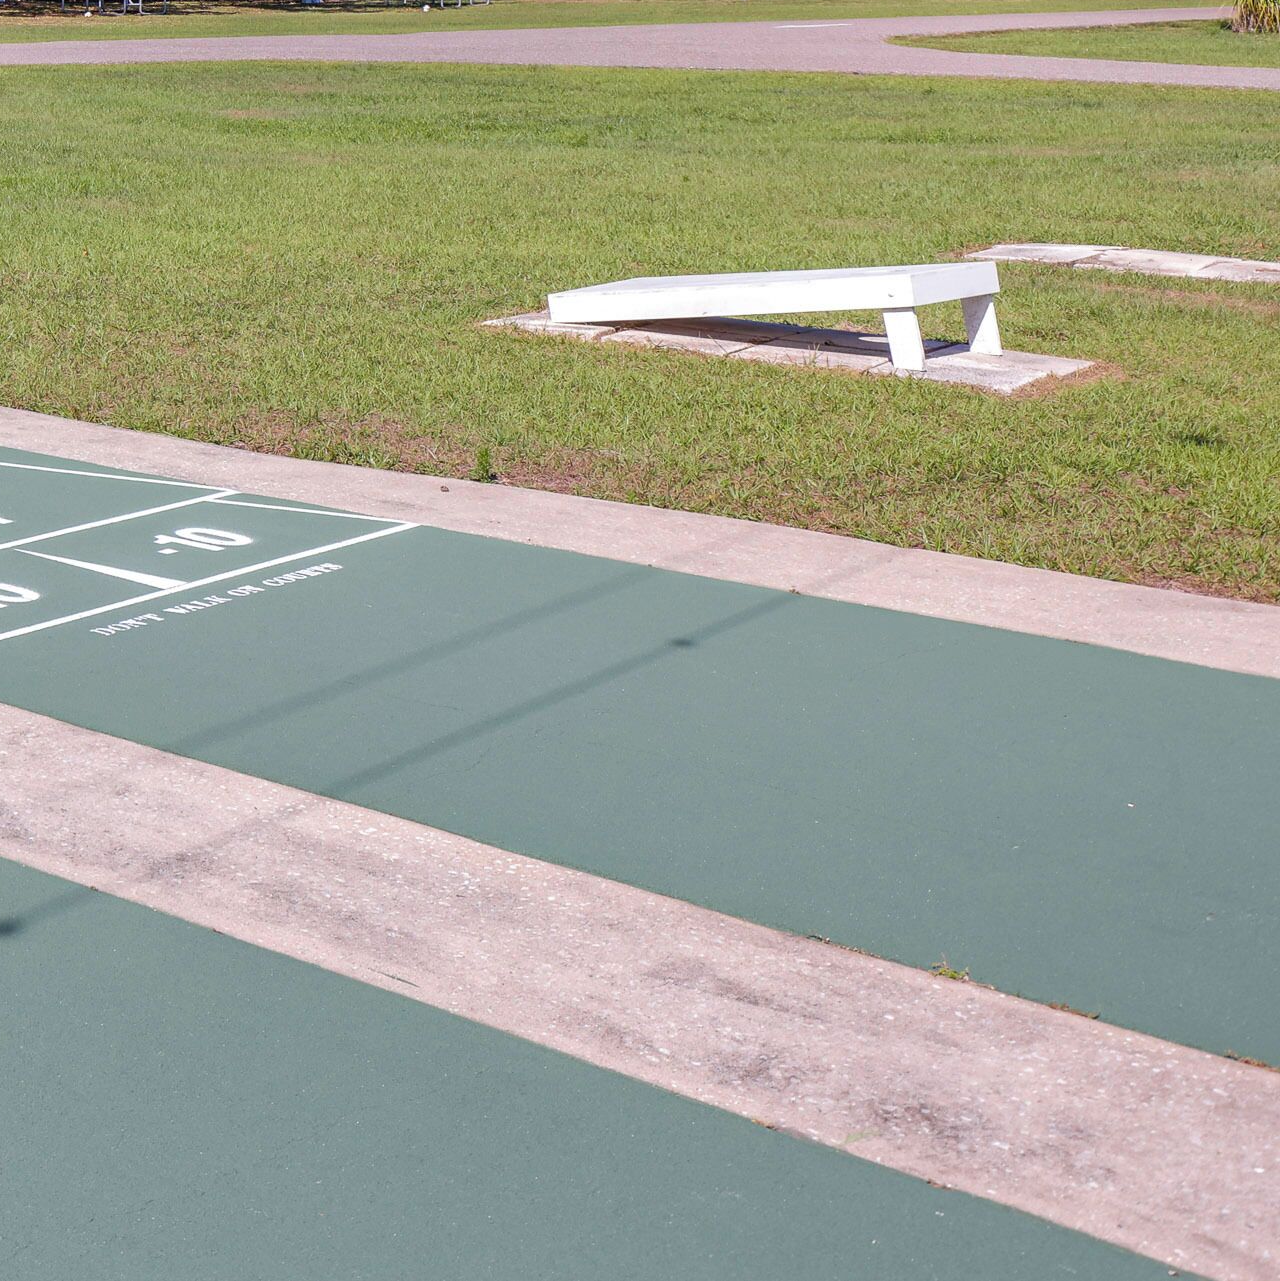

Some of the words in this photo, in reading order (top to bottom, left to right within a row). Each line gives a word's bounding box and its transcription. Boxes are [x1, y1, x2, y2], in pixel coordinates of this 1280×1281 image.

[154, 526, 256, 555] -10
[88, 612, 166, 637] DON'T
[162, 594, 233, 615] WALK
[226, 584, 266, 597] ON
